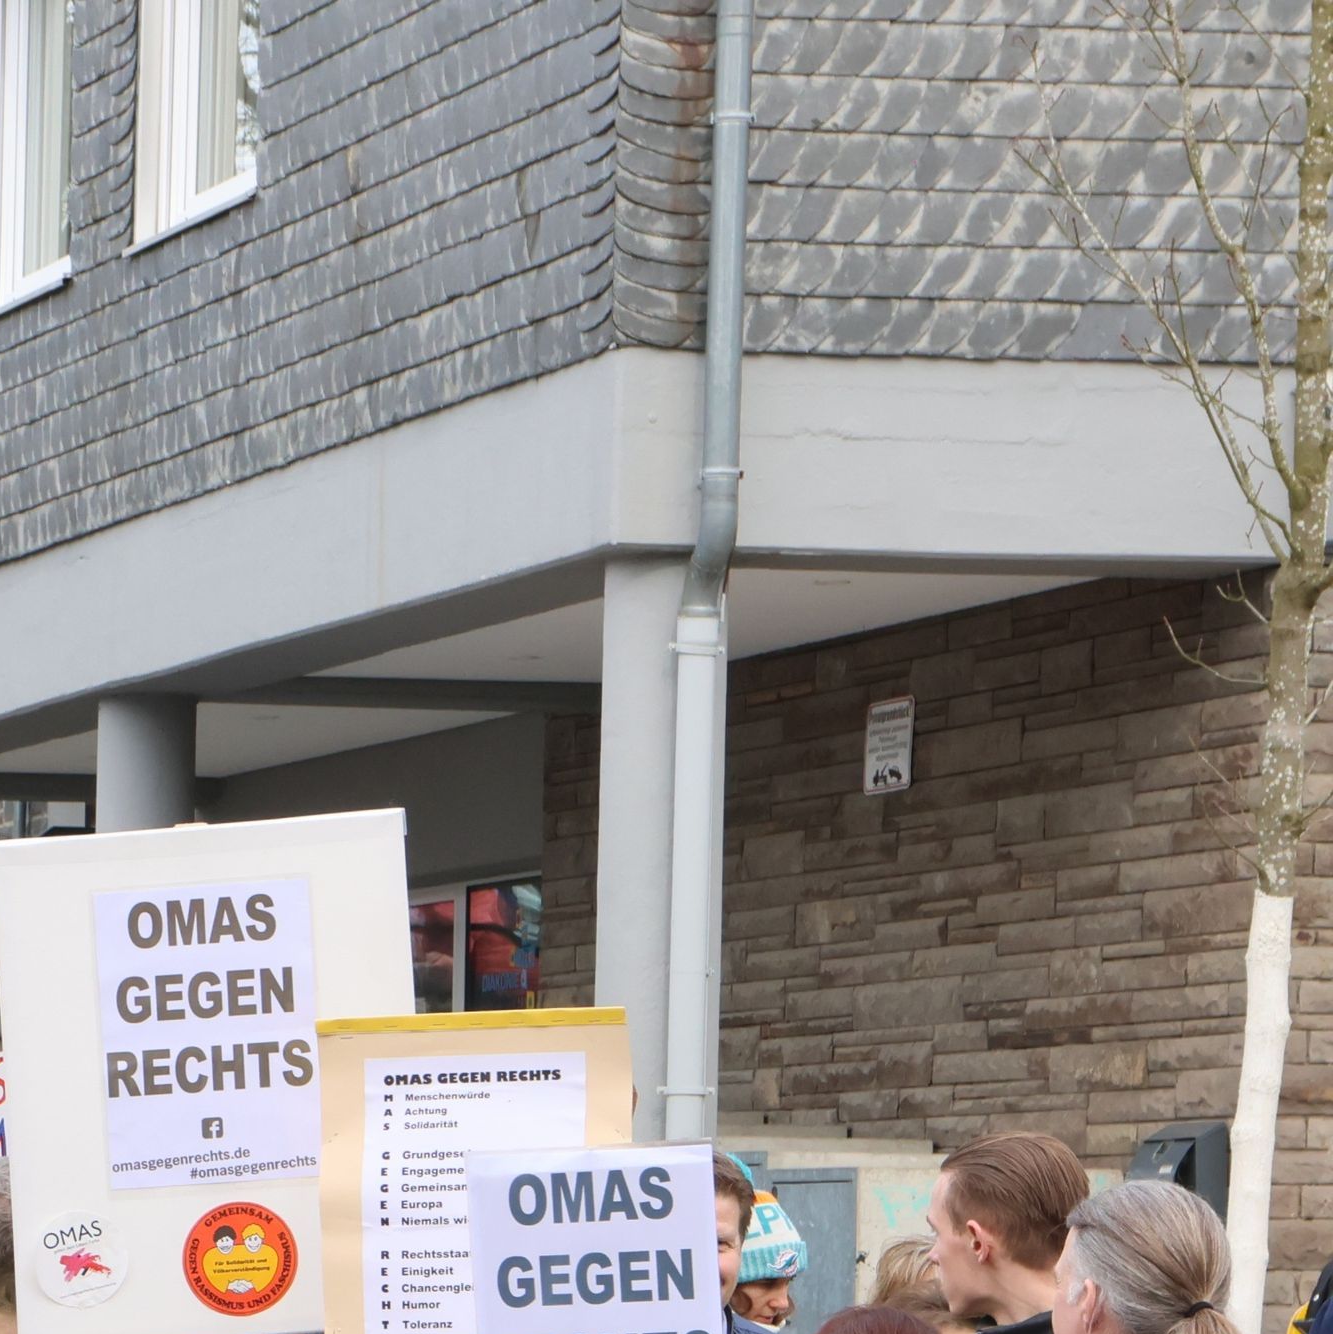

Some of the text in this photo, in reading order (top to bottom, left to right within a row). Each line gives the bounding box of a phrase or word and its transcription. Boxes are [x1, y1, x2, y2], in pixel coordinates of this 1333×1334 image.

[128, 894, 276, 948] OMAS
[116, 967, 294, 1023] GEGEN
[107, 1040, 313, 1098] RECHTS
[384, 1069, 562, 1086] OMAS GEGEN RECHTS
[384, 1091, 491, 1102] M Menschenwürde
[405, 1107, 447, 1116] Achtung
[383, 1120, 458, 1131] S Solidarität
[112, 1146, 251, 1174] omasgegenrechts.de
[382, 1150, 465, 1160] G Grundgese
[190, 1155, 317, 1180] #omasgegenrechts
[381, 1168, 388, 1176] E
[380, 1184, 389, 1193] G
[509, 1167, 673, 1225] OMAS
[380, 1200, 443, 1211] E Europa
[204, 1206, 273, 1227] GEMEINSAM
[381, 1215, 469, 1226] N Niemals wi
[43, 1220, 102, 1249] OMAS
[381, 1250, 390, 1259] R
[189, 1231, 292, 1310] GEGEN RASSISMUS UND FASCHISMUS
[381, 1266, 454, 1277] E Einigkeit
[497, 1249, 694, 1308] GEGEN
[381, 1284, 389, 1293] C
[382, 1301, 441, 1309] H Humor
[382, 1320, 453, 1329] T Toleranz
